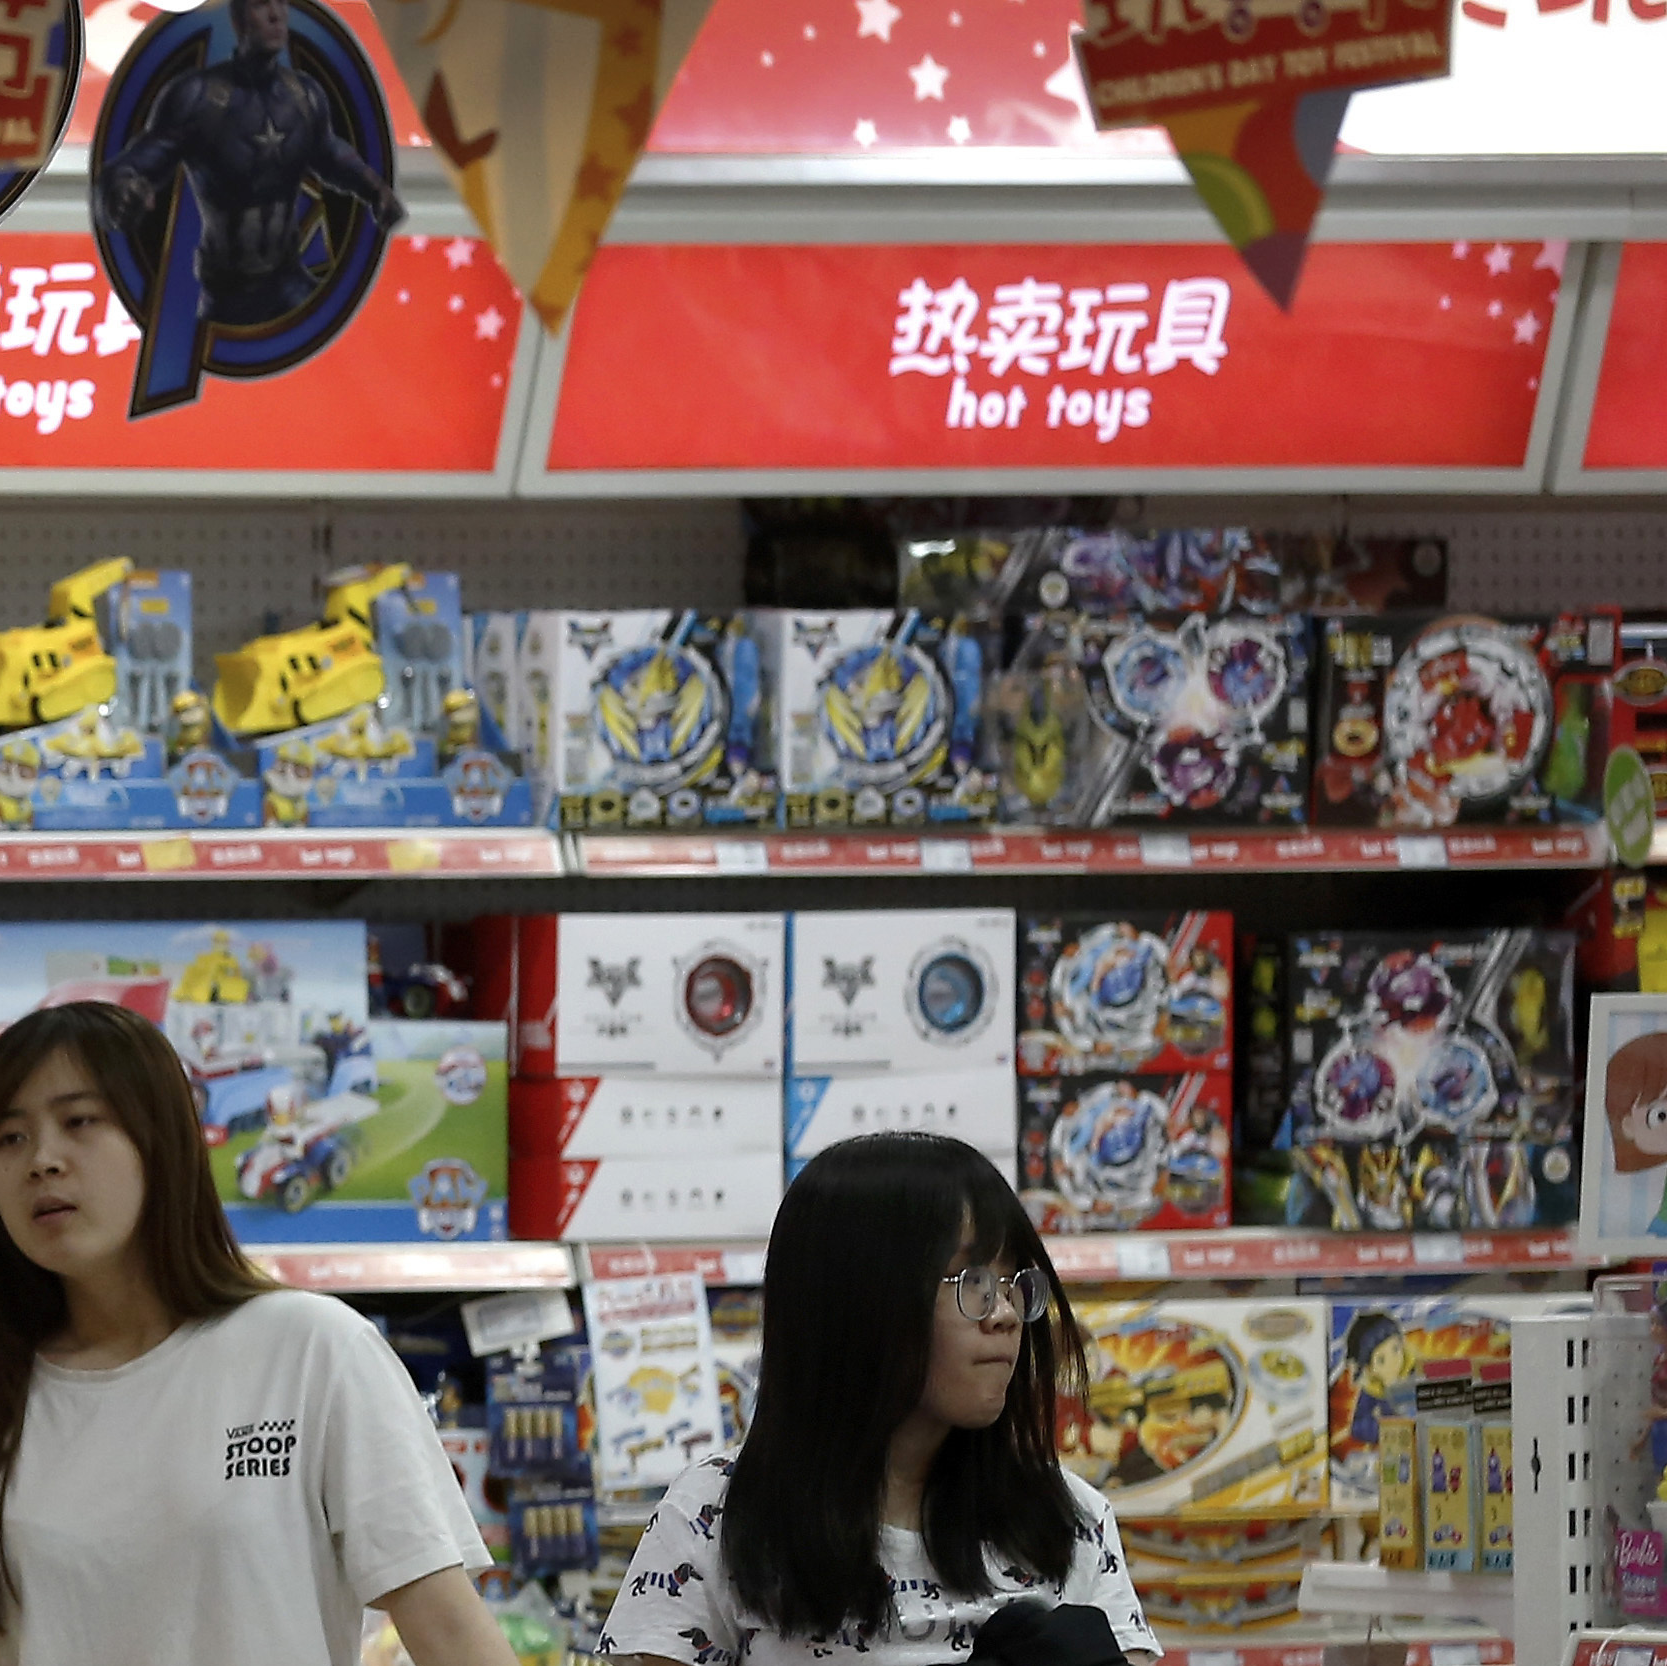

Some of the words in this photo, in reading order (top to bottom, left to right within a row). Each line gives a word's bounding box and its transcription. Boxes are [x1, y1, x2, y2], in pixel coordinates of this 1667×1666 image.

[1097, 67, 1222, 106] CHILDREN'S
[1229, 58, 1275, 87] DAY
[1280, 51, 1327, 80] TOY
[1331, 32, 1442, 74] FESTIVAL
[889, 278, 1231, 377] 热卖玩具
[948, 377, 1027, 429] hot
[1048, 382, 1150, 443] toys
[226, 1435, 297, 1460] STOOP
[226, 1457, 290, 1480] SERIES
